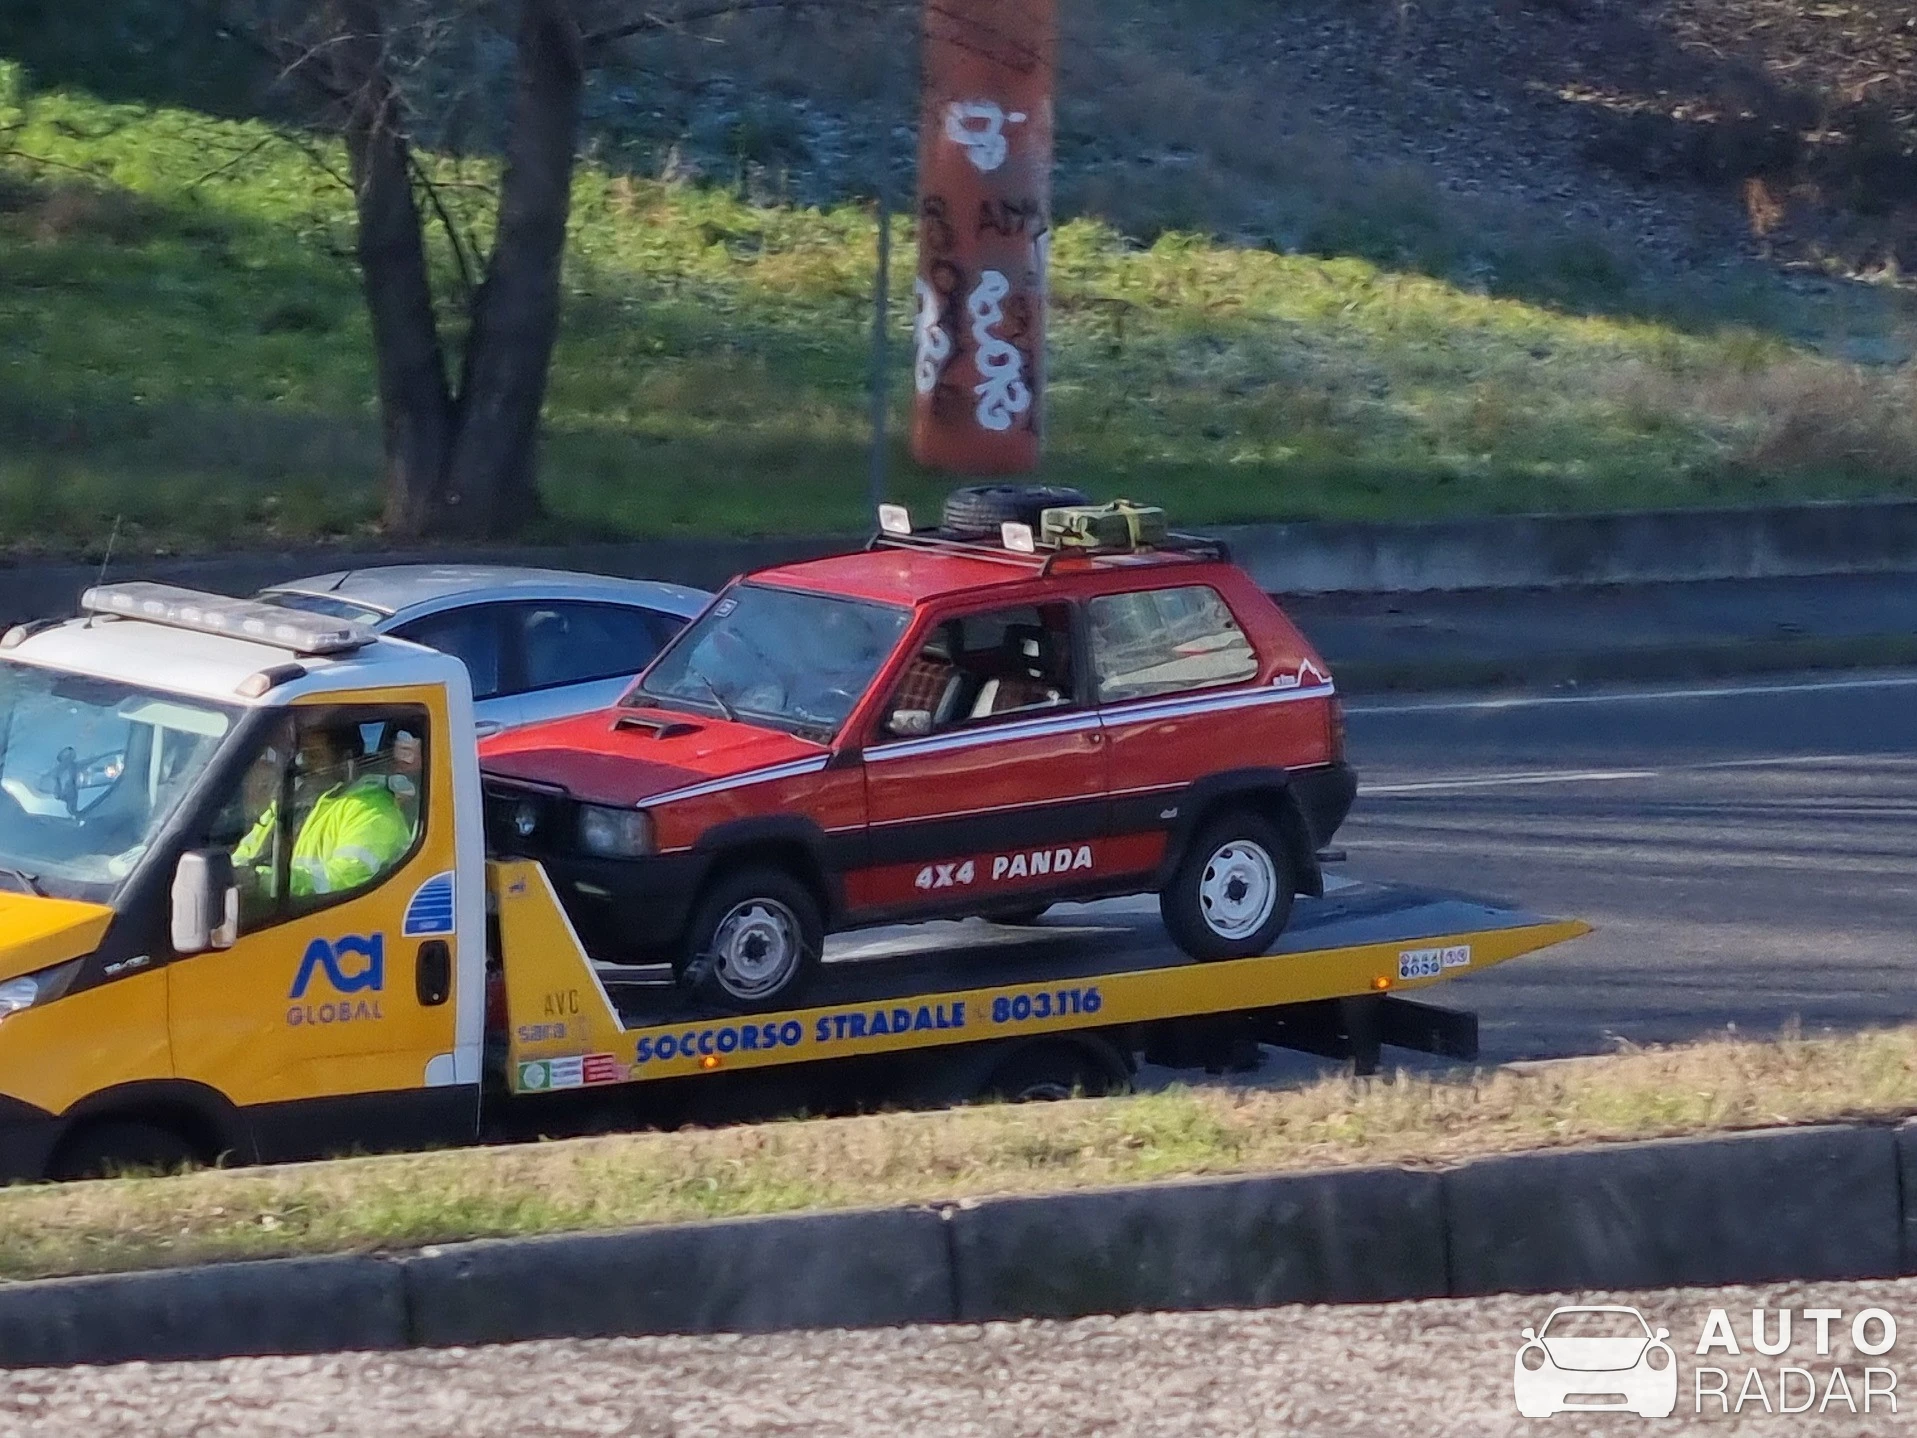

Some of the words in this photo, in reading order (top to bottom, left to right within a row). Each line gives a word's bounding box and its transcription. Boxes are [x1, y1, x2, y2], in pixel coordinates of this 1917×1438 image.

[915, 860, 975, 890] 4X4
[992, 845, 1093, 881] PANDA
[286, 1000, 384, 1026] GLOBAL
[636, 1020, 802, 1064] SOCCORSO
[815, 1002, 966, 1042] STRADALE
